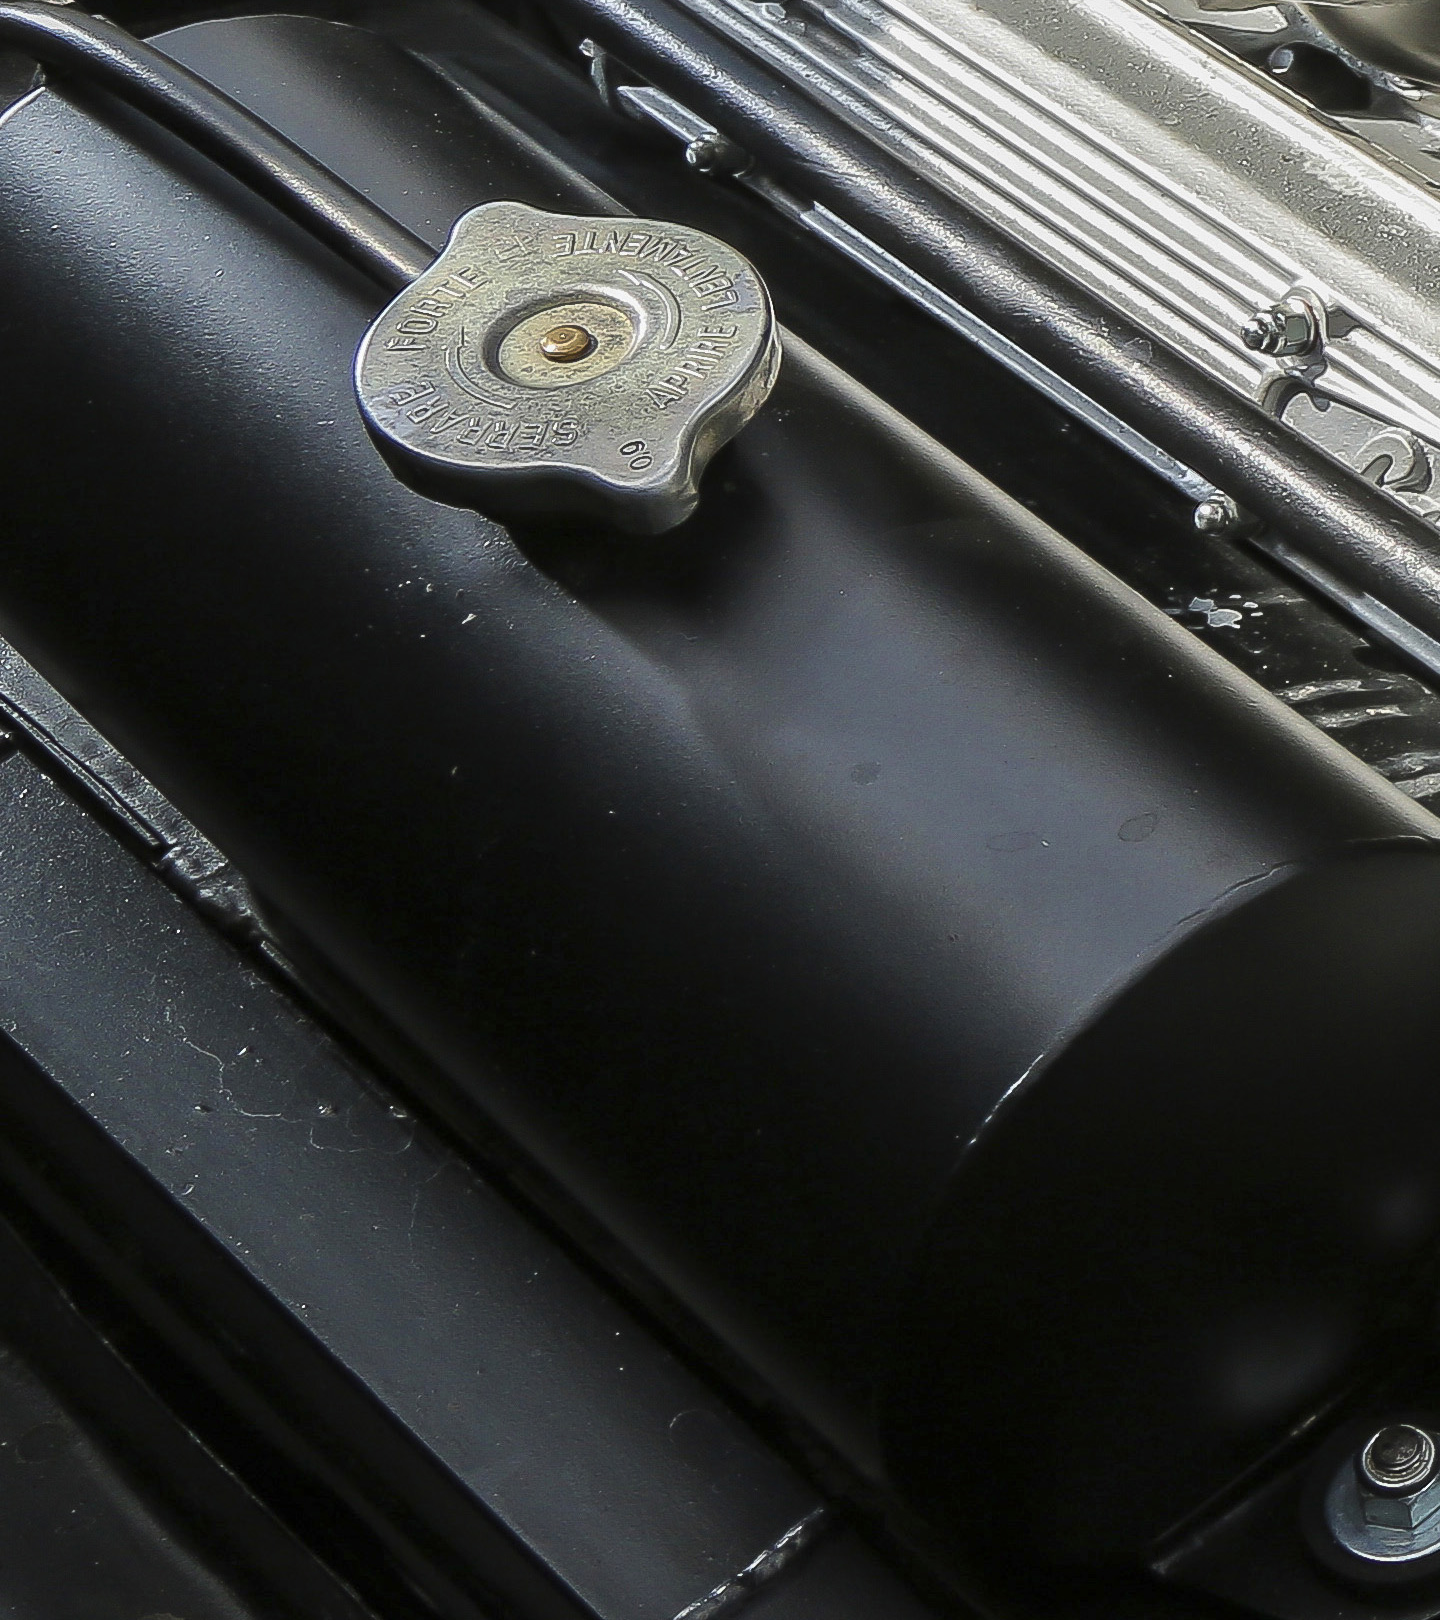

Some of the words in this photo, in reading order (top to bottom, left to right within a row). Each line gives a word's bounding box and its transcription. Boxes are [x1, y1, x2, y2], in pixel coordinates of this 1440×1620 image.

[384, 266, 491, 352] FORTE
[647, 326, 737, 409] APRIRE
[388, 380, 580, 452] SERRARE
